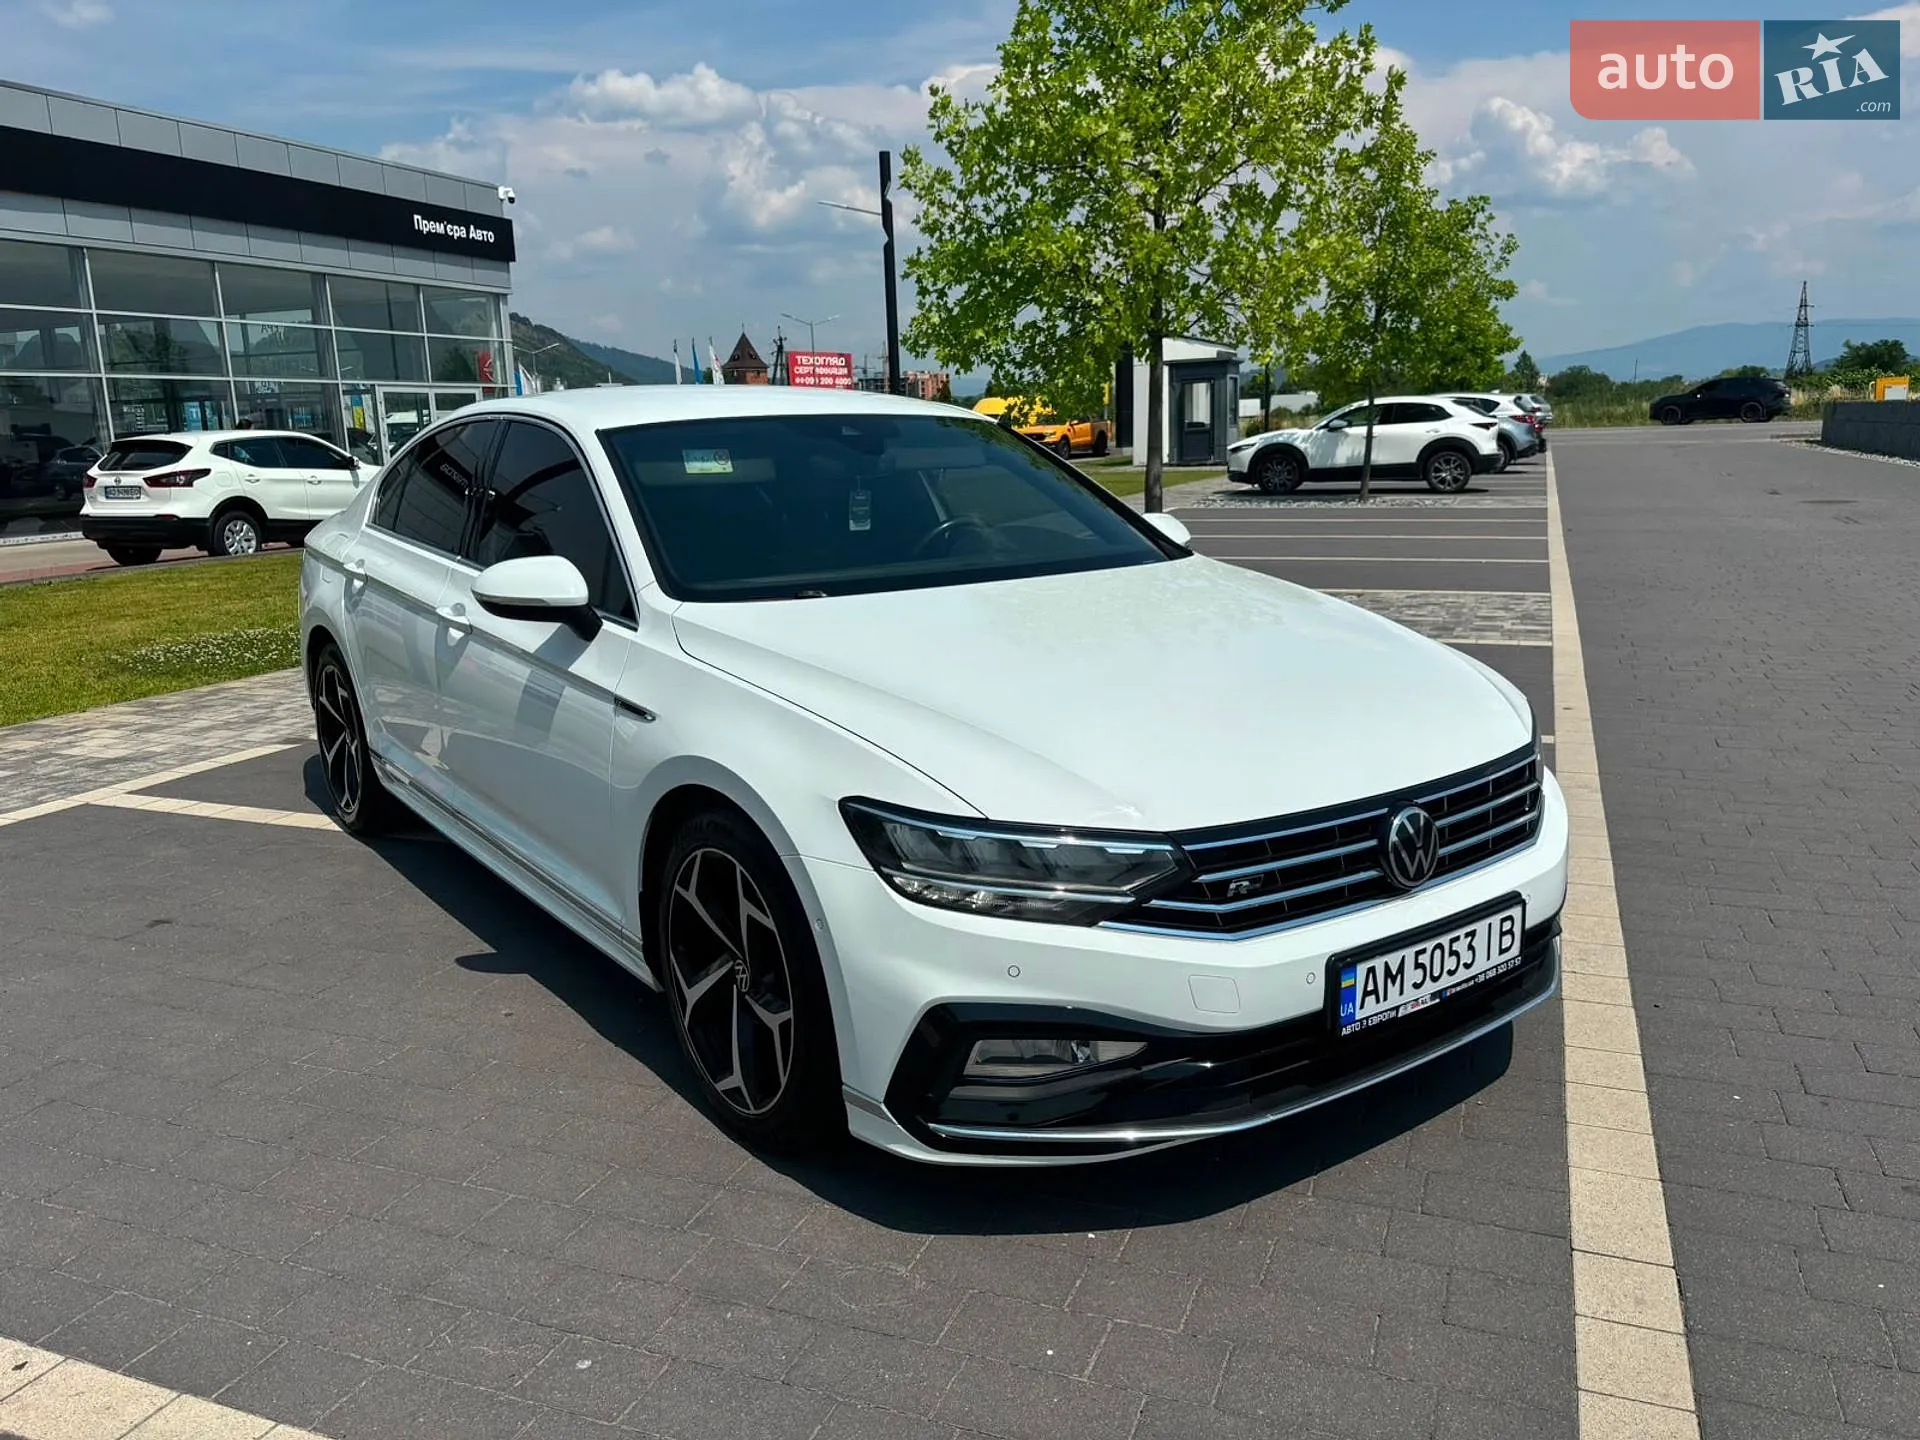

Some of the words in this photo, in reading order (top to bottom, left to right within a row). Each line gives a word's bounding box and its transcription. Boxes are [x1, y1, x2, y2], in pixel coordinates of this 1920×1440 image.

[469, 224, 495, 243] Авто
[1359, 954, 1406, 1010] AM
[1412, 929, 1477, 990] 5053
[1486, 914, 1515, 962] IB
[1340, 1001, 1354, 1017] UA
